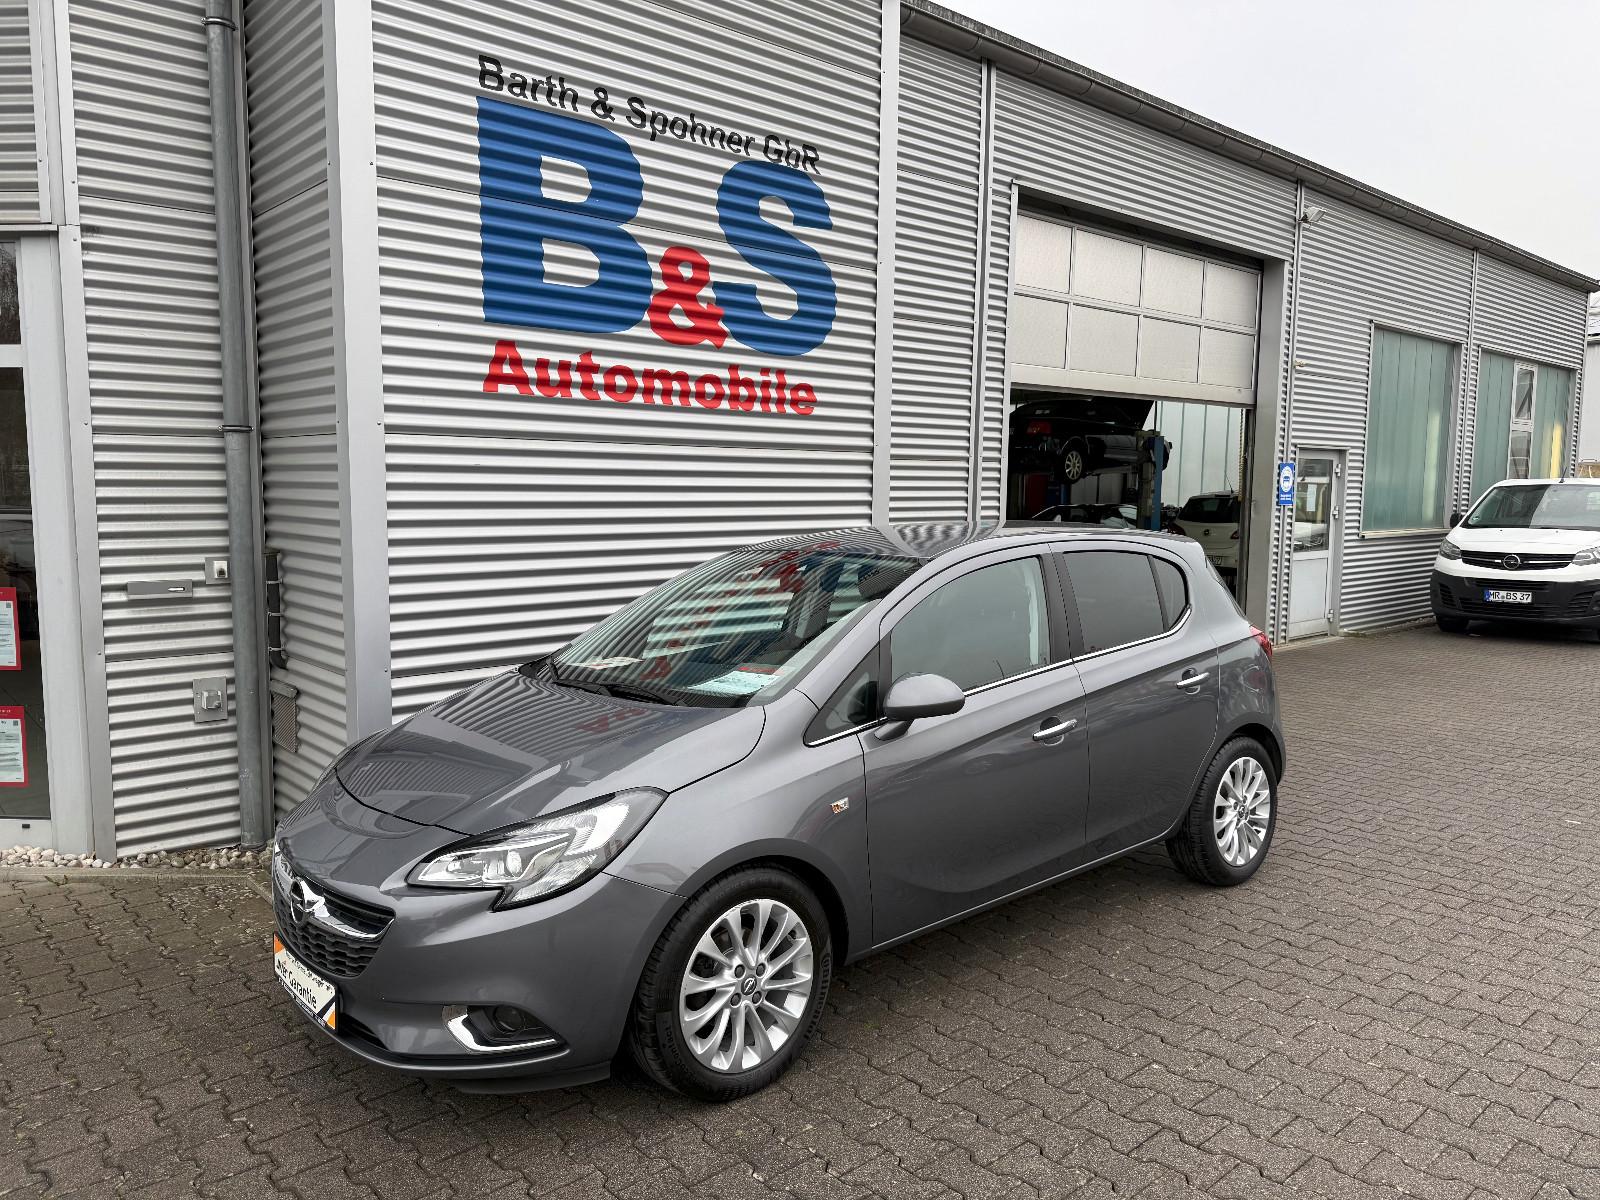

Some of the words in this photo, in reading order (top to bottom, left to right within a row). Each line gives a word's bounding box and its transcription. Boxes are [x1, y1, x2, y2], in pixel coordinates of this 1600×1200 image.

[477, 54, 580, 113] Barth
[590, 86, 616, 122] &
[625, 96, 756, 156] Spohner
[763, 134, 822, 175] GbR
[482, 339, 819, 416] Automobile
[1505, 592, 1518, 601] BS
[1519, 593, 1531, 601] 37
